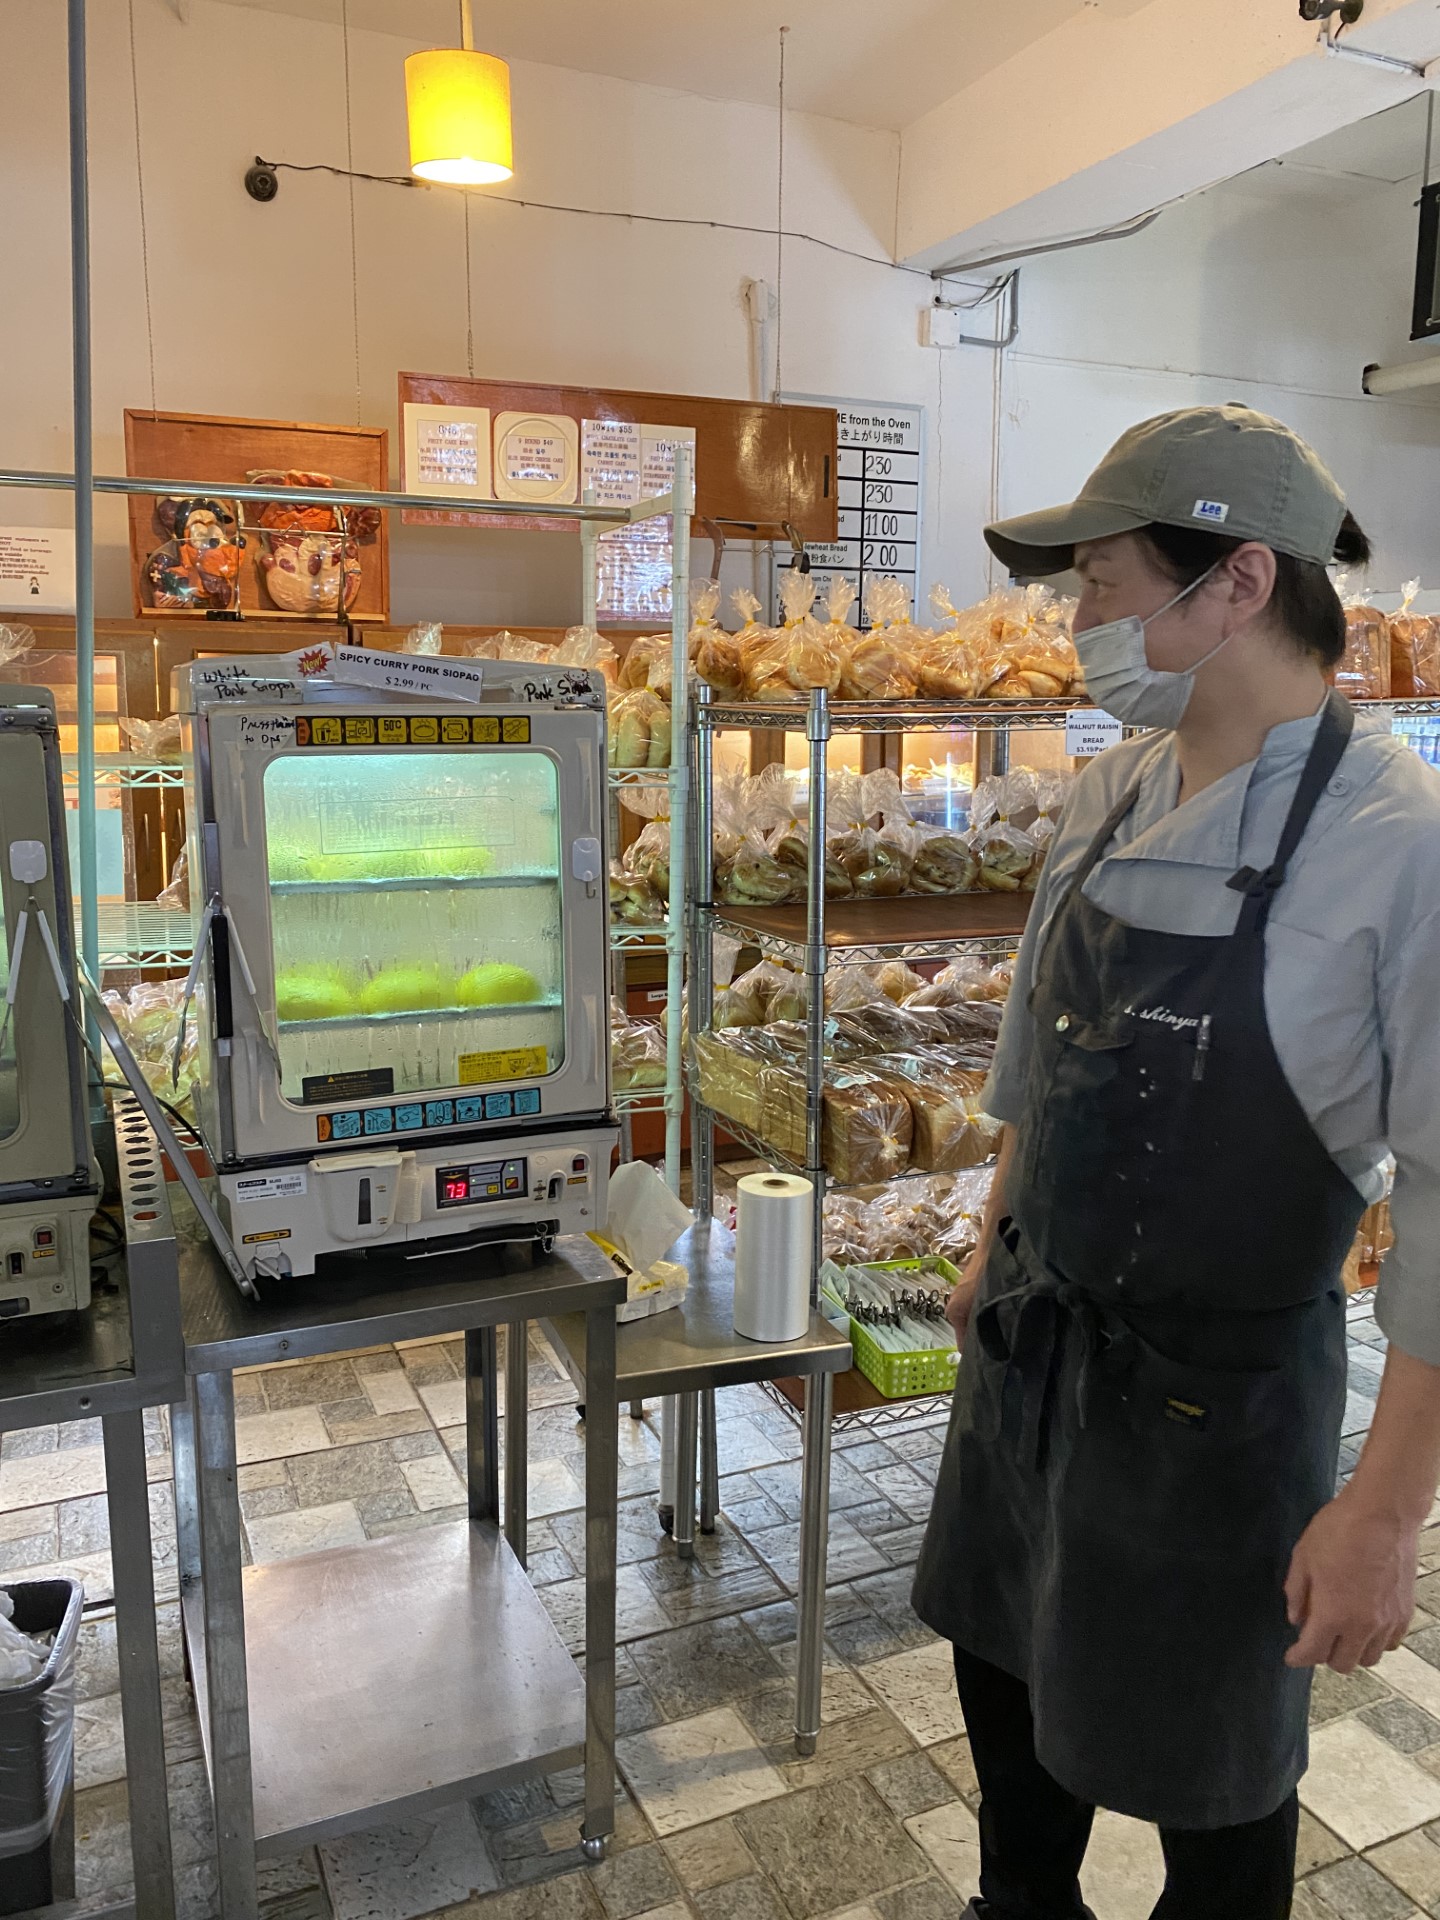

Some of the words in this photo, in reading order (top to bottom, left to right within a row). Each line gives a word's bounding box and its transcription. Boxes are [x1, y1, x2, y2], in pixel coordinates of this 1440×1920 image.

[849, 413, 870, 426] from
[872, 416, 886, 428] the
[888, 417, 911, 429] Oven
[837, 427, 904, 446] き上がり時間
[866, 483, 893, 504] 230
[1200, 501, 1222, 515] Lee
[830, 544, 848, 552] Bread
[302, 654, 323, 672] New!
[339, 652, 371, 665] SPICY
[373, 658, 409, 671] CURRY
[412, 663, 440, 676] PORK
[442, 668, 480, 682] SIOPAO
[203, 665, 250, 683] White
[214, 683, 248, 699] Pork
[523, 682, 554, 703] Pork
[244, 734, 255, 744] to
[1139, 1005, 1200, 1031] shinya
[446, 1181, 467, 1199] 73
